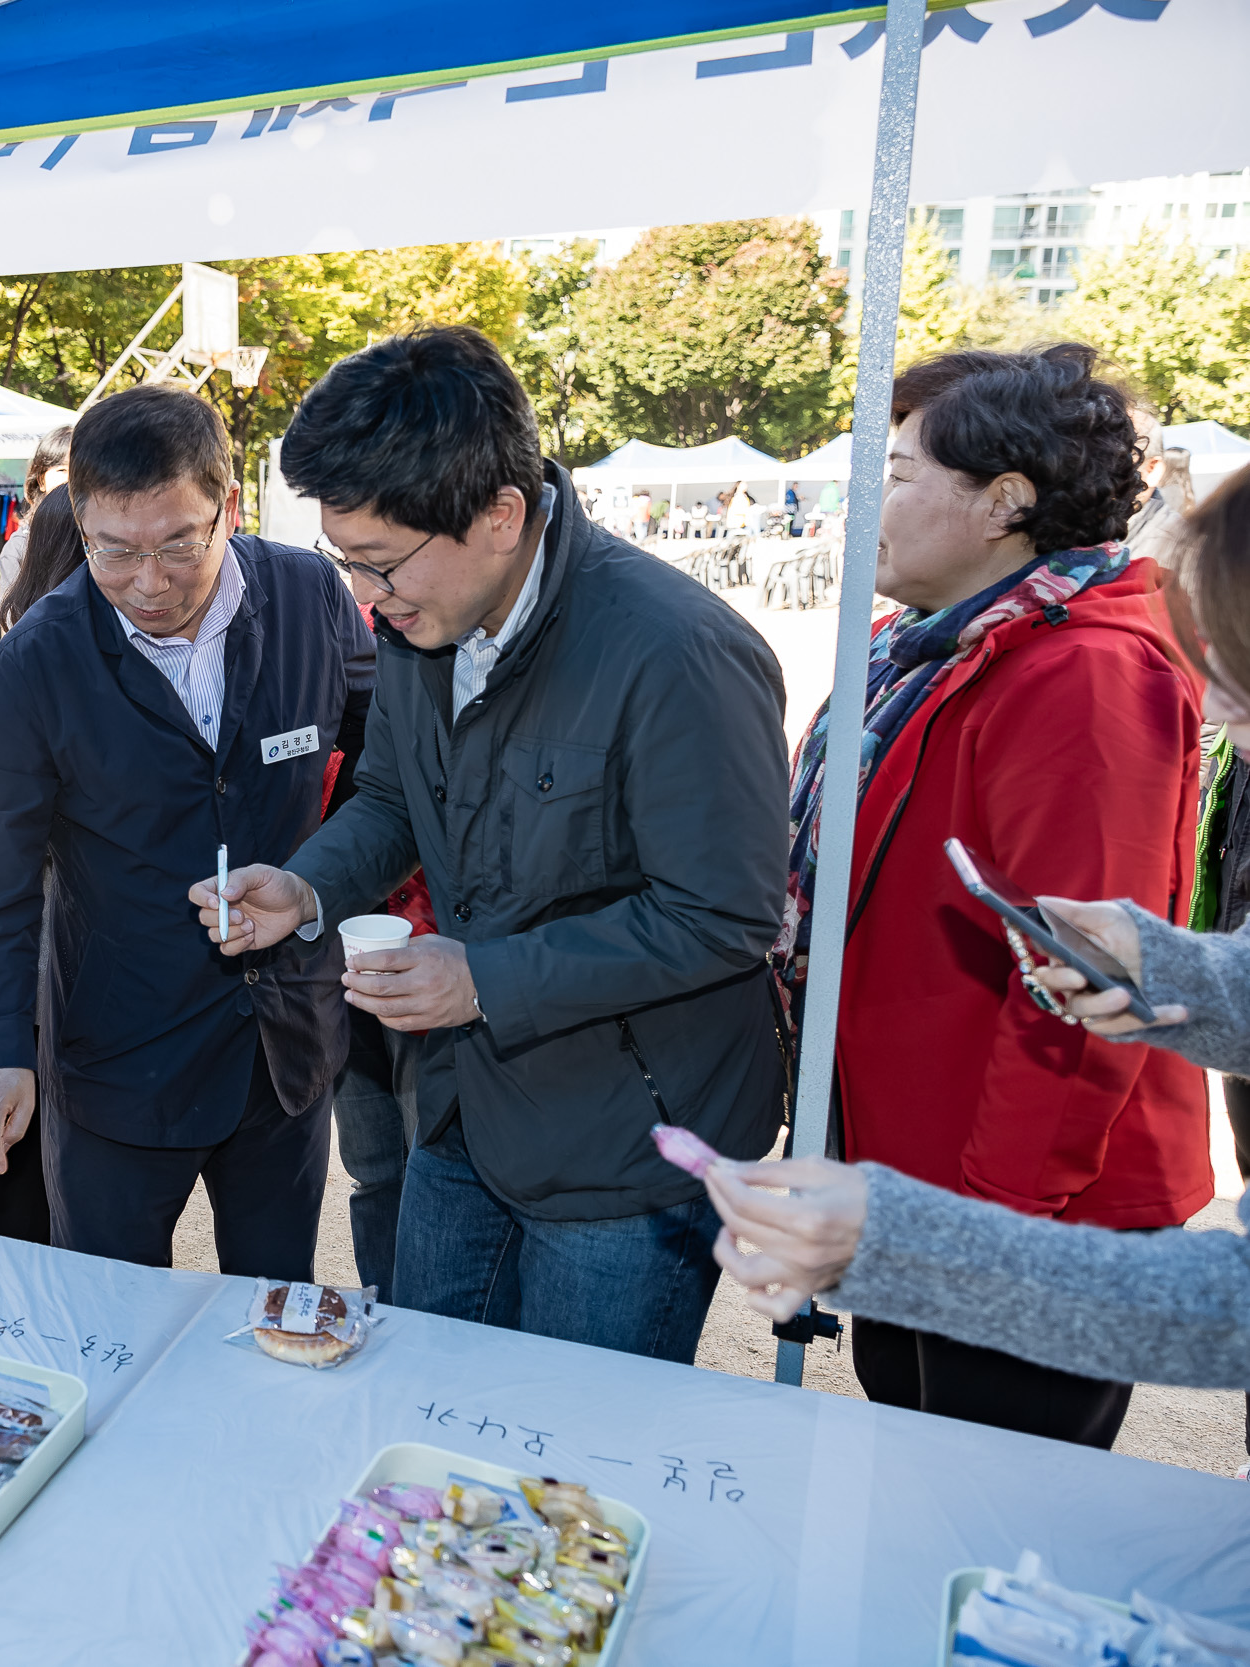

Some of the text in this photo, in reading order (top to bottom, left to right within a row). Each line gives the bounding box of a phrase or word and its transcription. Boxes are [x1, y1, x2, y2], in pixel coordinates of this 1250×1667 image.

[80, 1334, 134, 1373] 한국
[416, 1401, 554, 1457] 모나카
[658, 1454, 745, 1503] 일본
